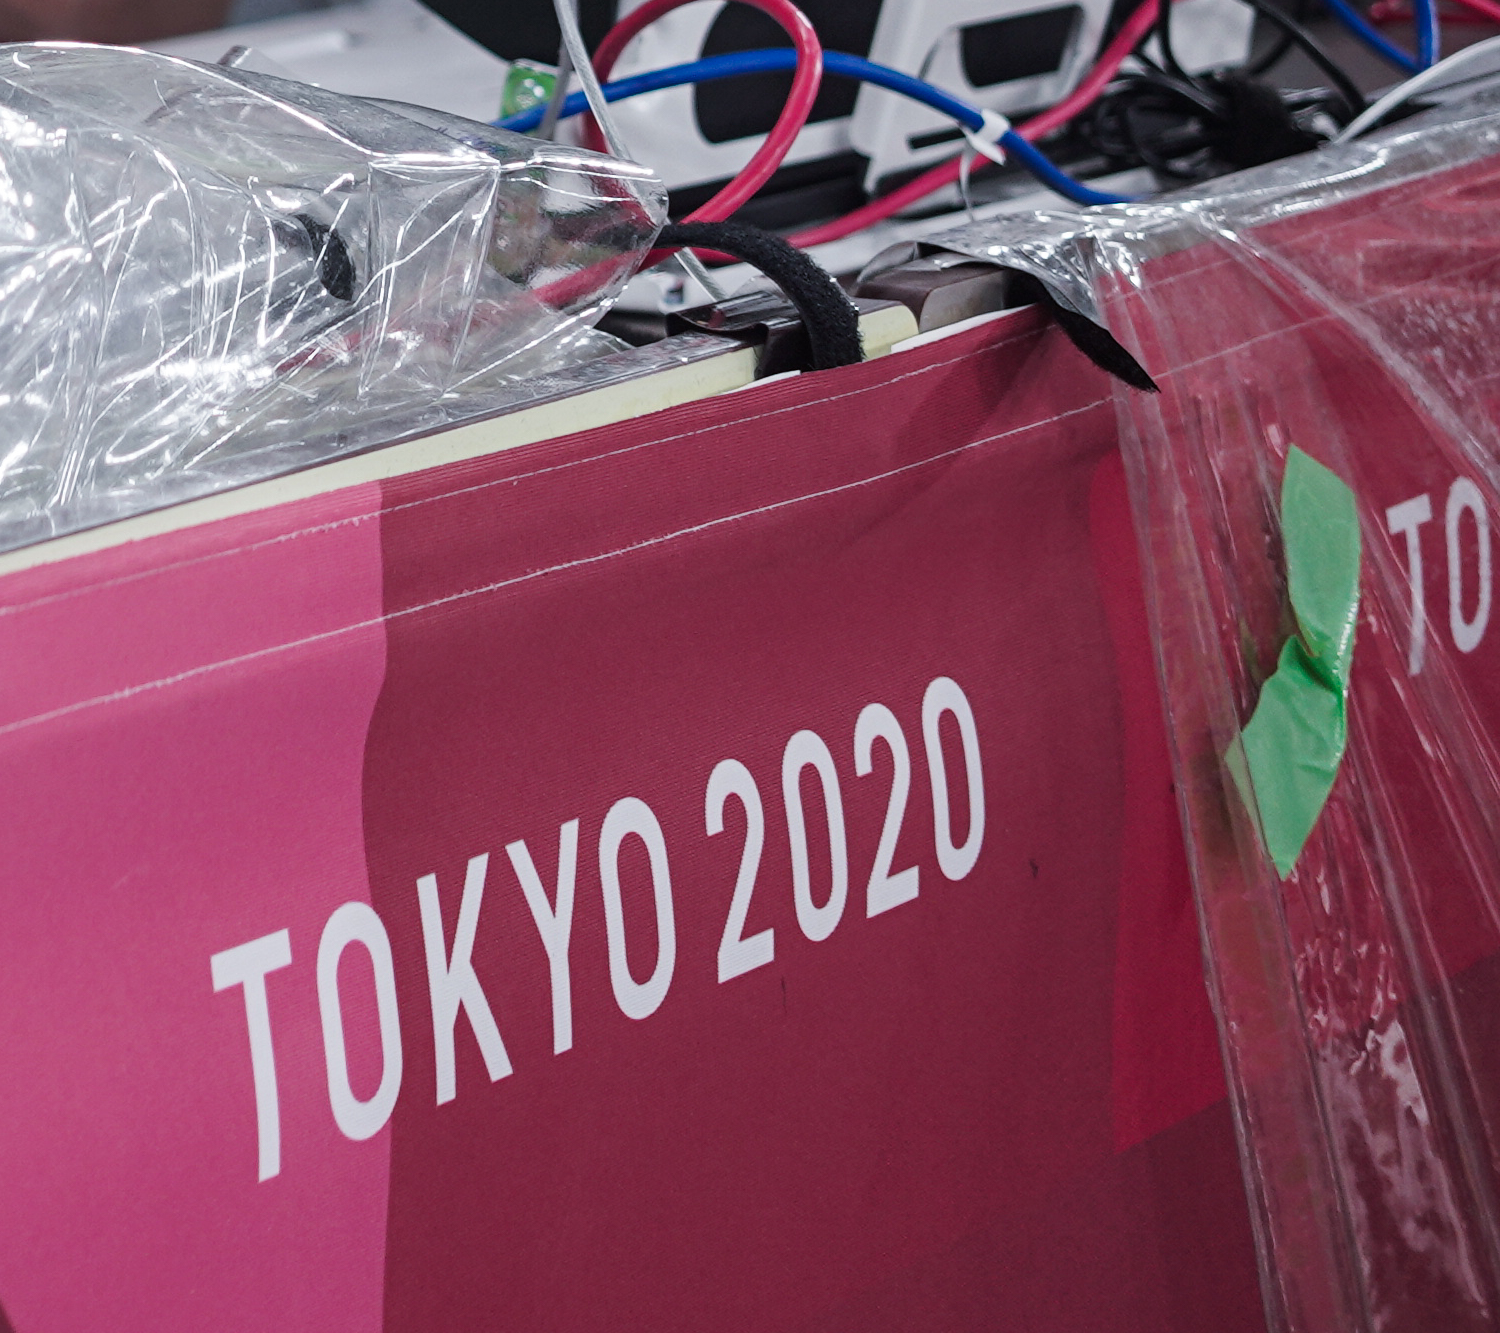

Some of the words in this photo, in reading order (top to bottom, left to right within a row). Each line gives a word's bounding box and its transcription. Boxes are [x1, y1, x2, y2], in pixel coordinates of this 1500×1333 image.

[1385, 476, 1492, 677] TO
[211, 796, 677, 1183] TOKYO
[705, 676, 986, 985] 2020
